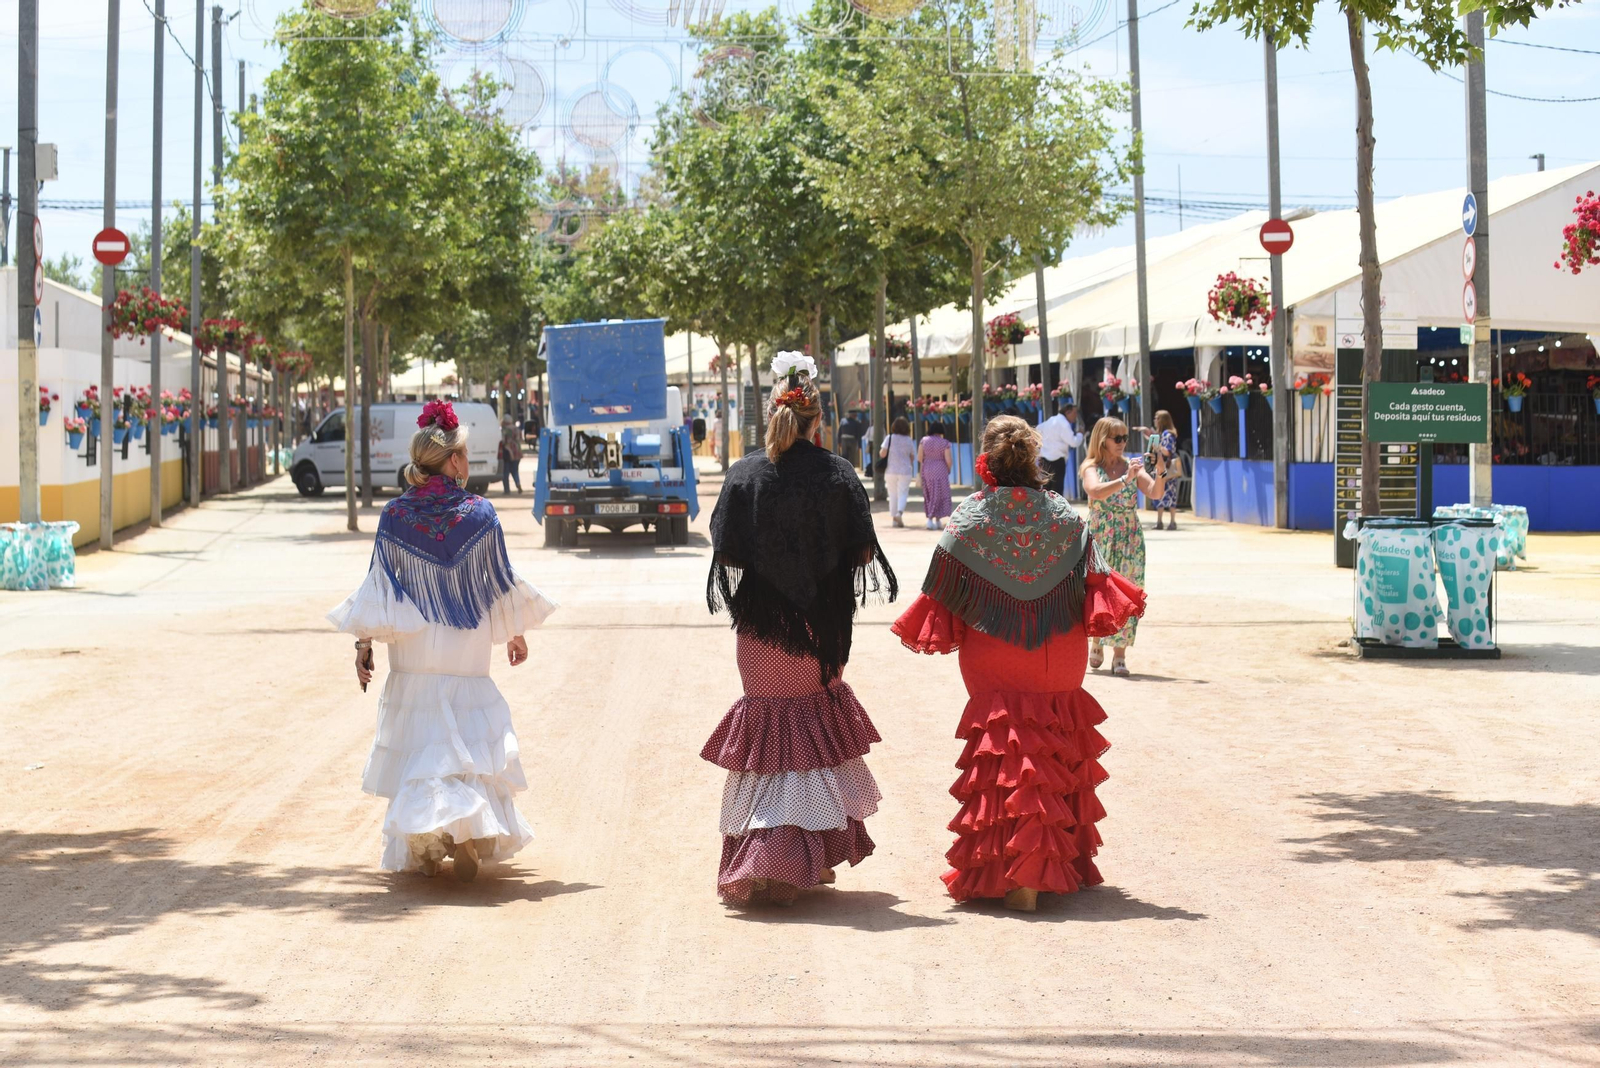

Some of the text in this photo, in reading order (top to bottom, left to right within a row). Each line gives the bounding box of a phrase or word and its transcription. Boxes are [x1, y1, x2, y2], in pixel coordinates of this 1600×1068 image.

[1419, 387, 1446, 396] sadeco
[1389, 402, 1466, 412] Cada gesto cuenta.
[1374, 412, 1481, 422] Deposita aquí tus residuos
[600, 503, 637, 513] 7008 KJB
